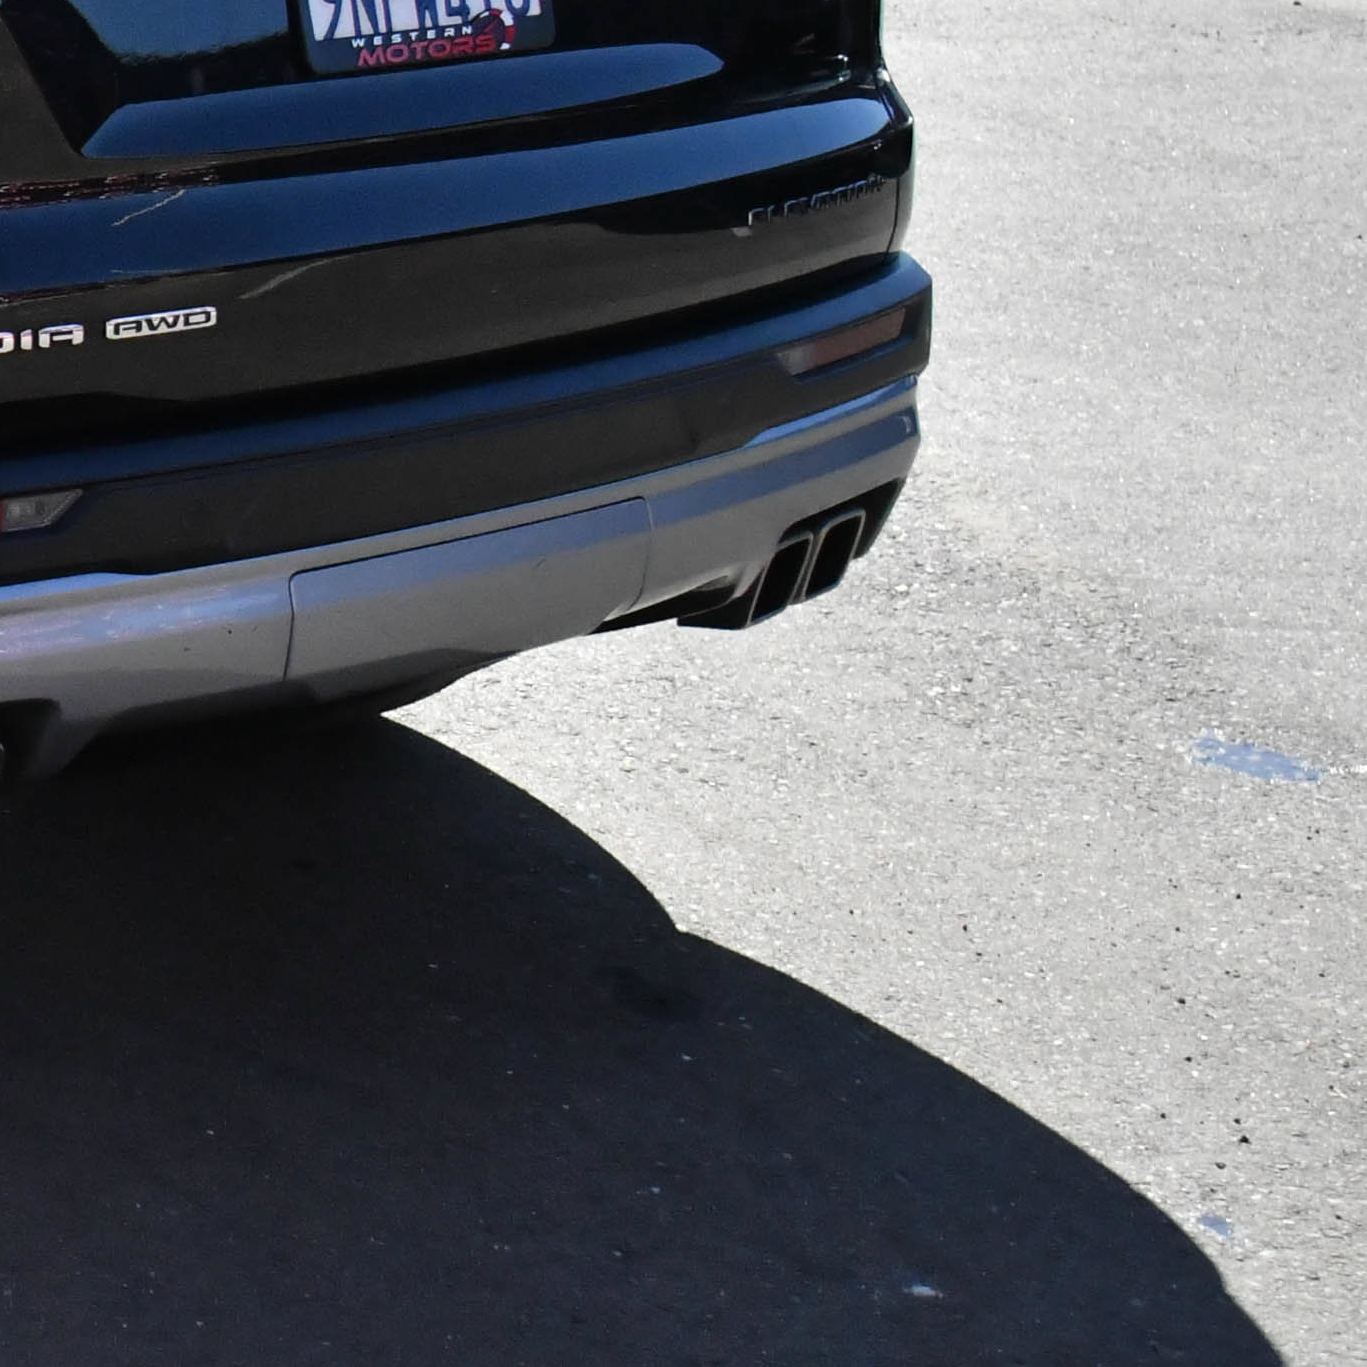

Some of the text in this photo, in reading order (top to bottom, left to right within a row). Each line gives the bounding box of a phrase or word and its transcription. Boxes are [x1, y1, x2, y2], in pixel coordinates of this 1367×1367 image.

[351, 25, 473, 48] WESTERN
[357, 35, 497, 68] MOTORS
[110, 308, 214, 336] AWD
